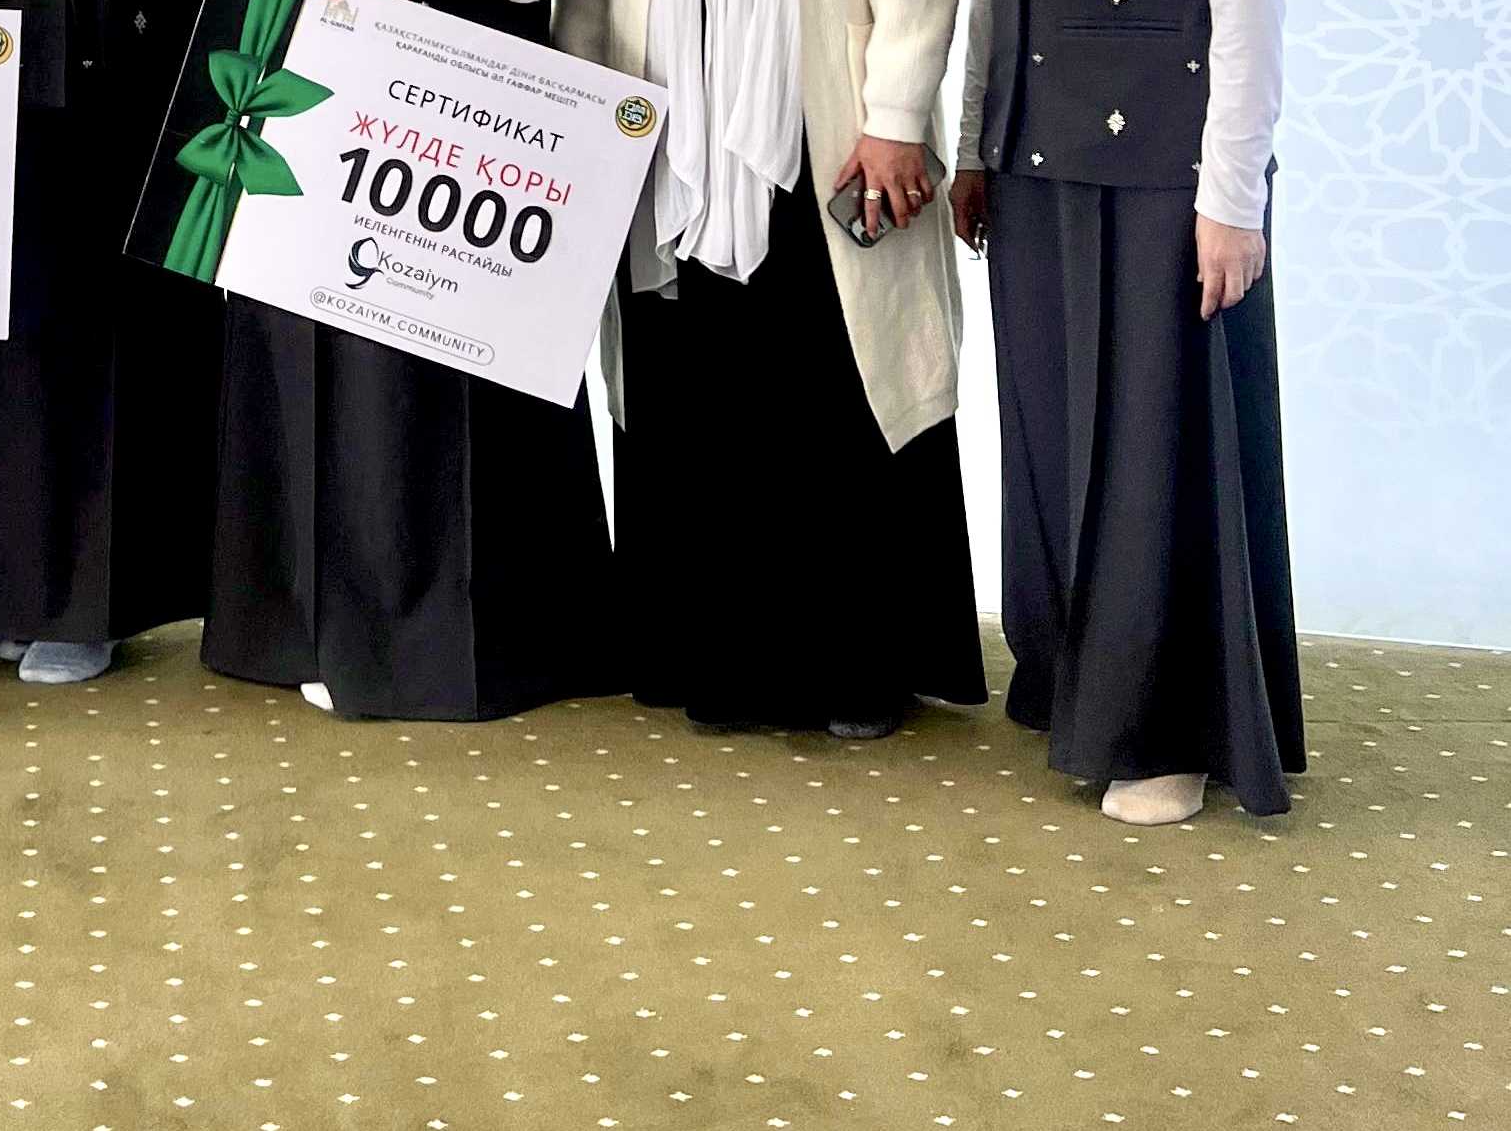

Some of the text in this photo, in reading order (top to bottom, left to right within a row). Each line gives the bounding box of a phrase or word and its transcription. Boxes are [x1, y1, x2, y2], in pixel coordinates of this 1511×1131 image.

[389, 80, 565, 152] СЕРТИФИКАТ
[350, 111, 572, 205] ЖҮЛДЕ ҚОРЫ
[340, 148, 553, 263] 10000
[354, 216, 513, 277] ИЕЛЕНГЕНІН РАСТАЙДЫ
[378, 251, 458, 293] Kozaiym
